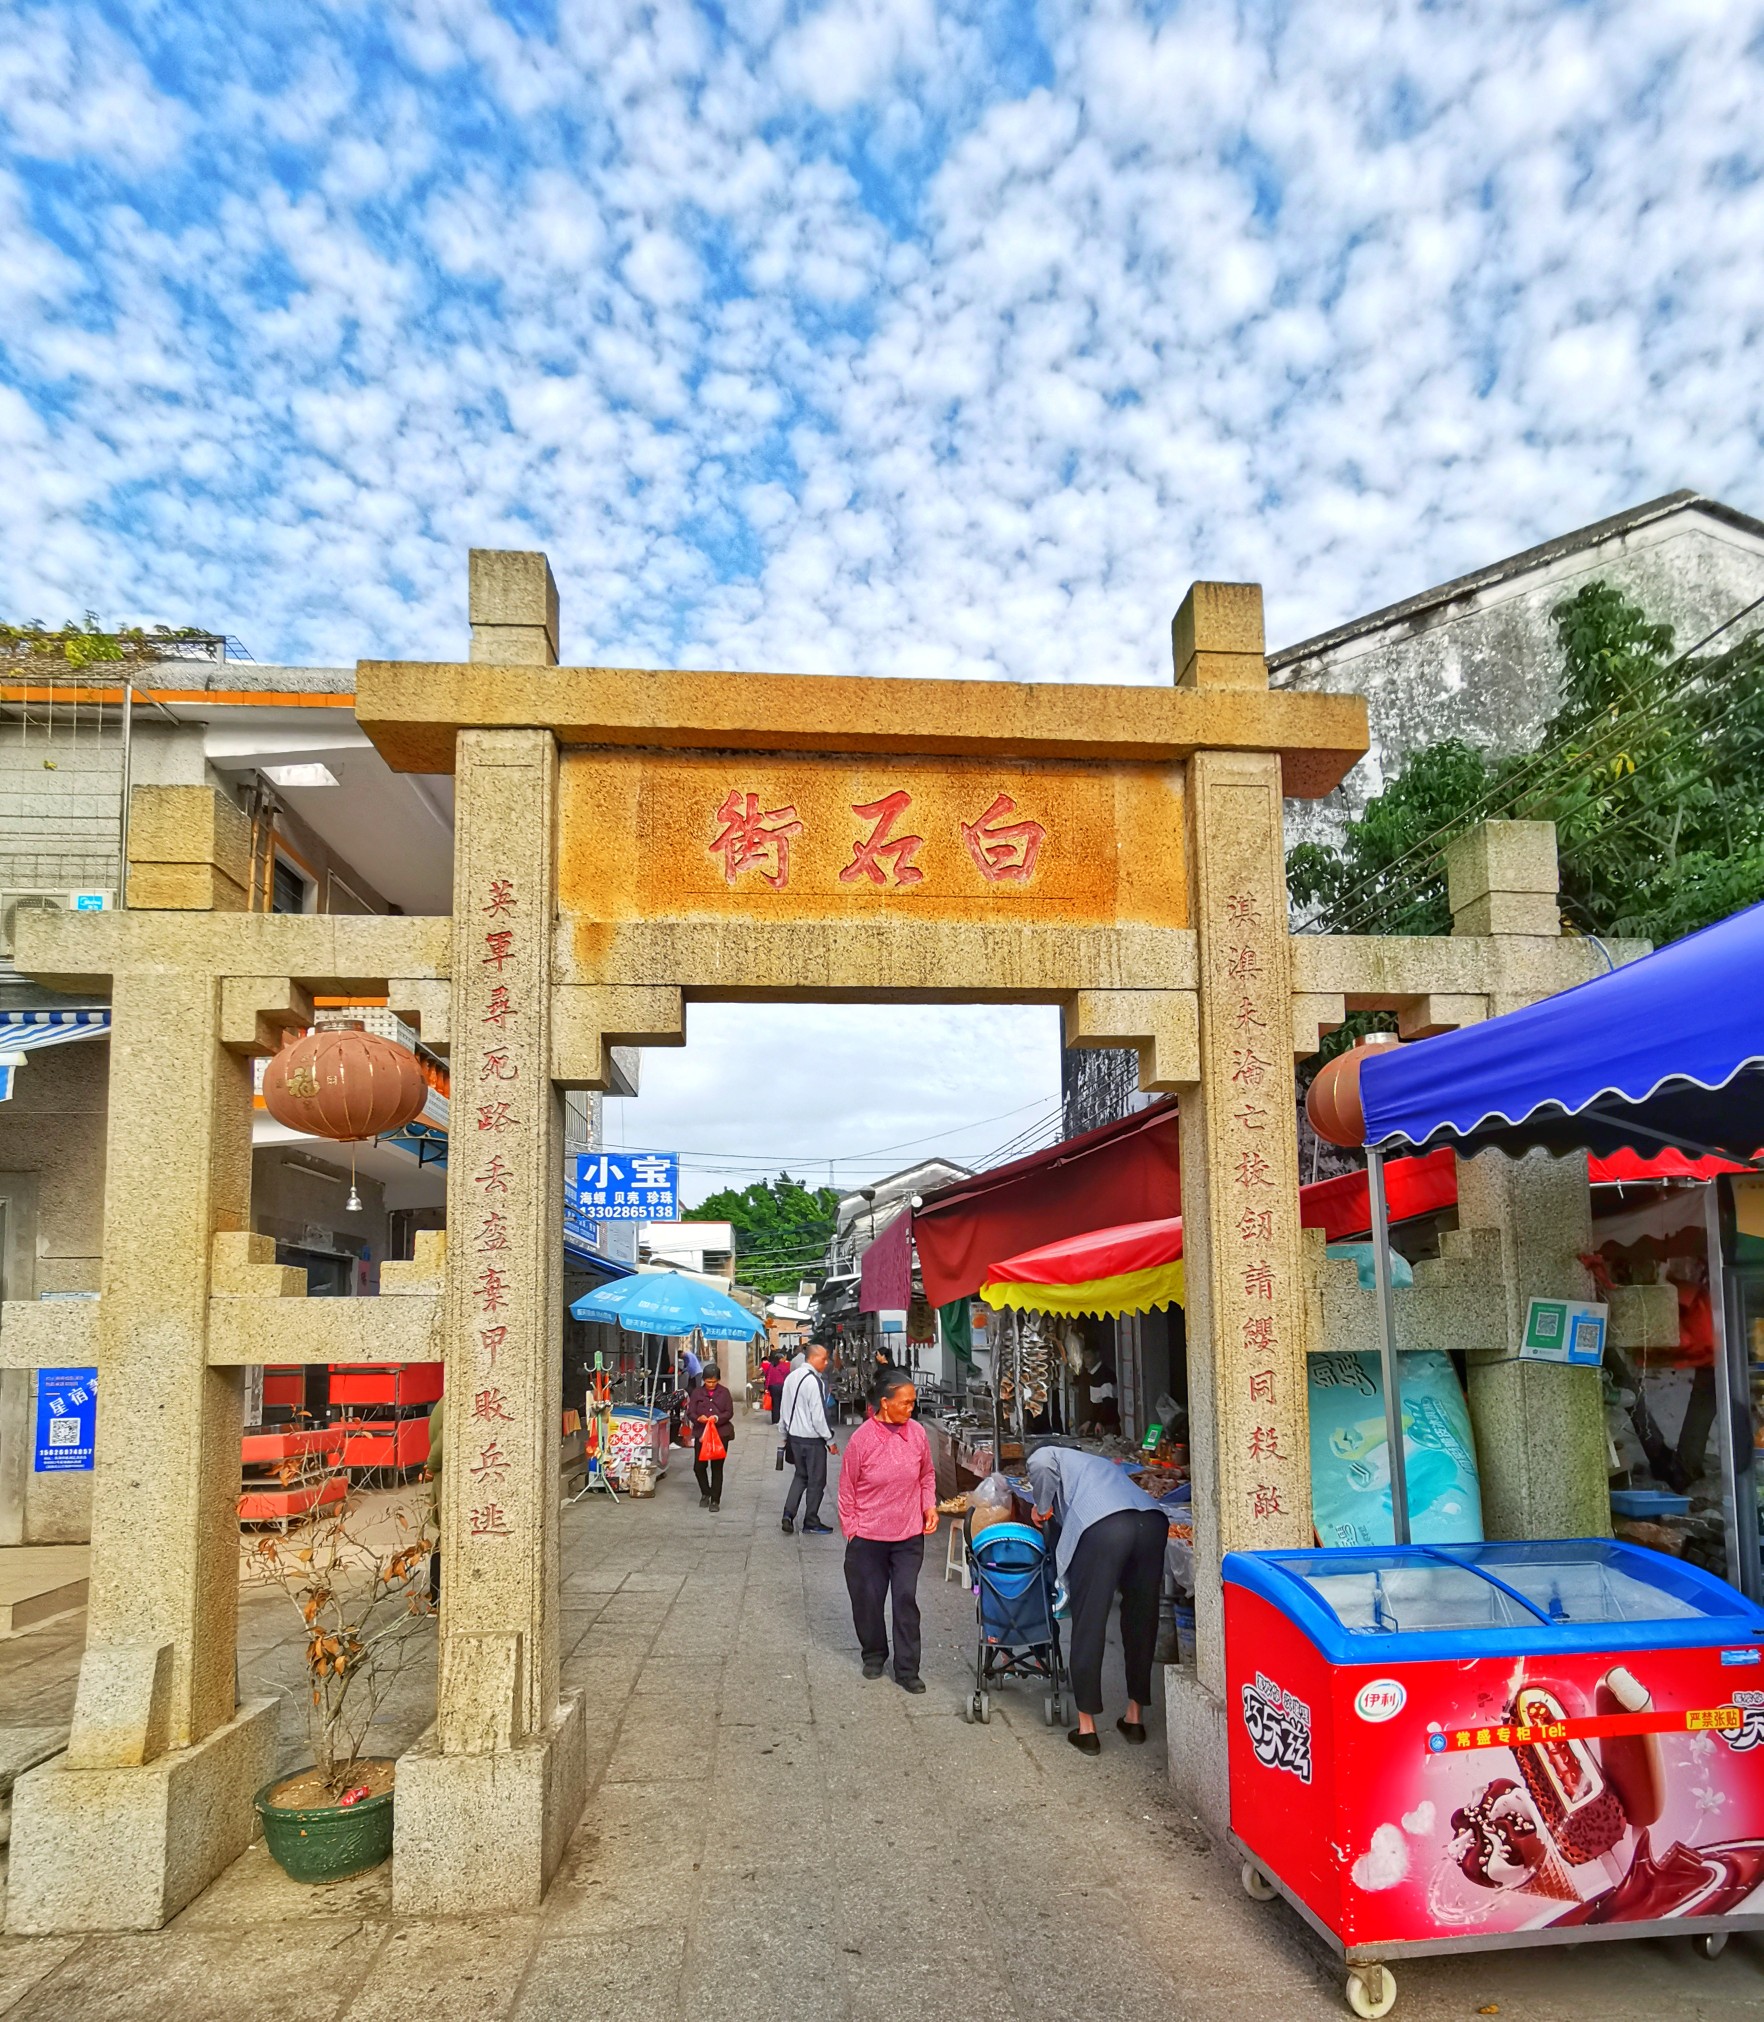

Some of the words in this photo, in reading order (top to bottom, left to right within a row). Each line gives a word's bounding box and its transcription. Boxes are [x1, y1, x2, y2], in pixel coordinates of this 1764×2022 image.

[583, 1155, 671, 1189] 小宝
[580, 1191, 606, 1205] 海螺
[613, 1191, 640, 1205] 贝壳
[646, 1190, 673, 1205] 珍珠
[580, 1206, 674, 1218] 13302865138
[1364, 1693, 1397, 1708] 伊利
[1689, 1711, 1738, 1728] 严禁张贴
[1456, 1726, 1531, 1747] 常盛专柜
[1539, 1722, 1567, 1739] Tel:
